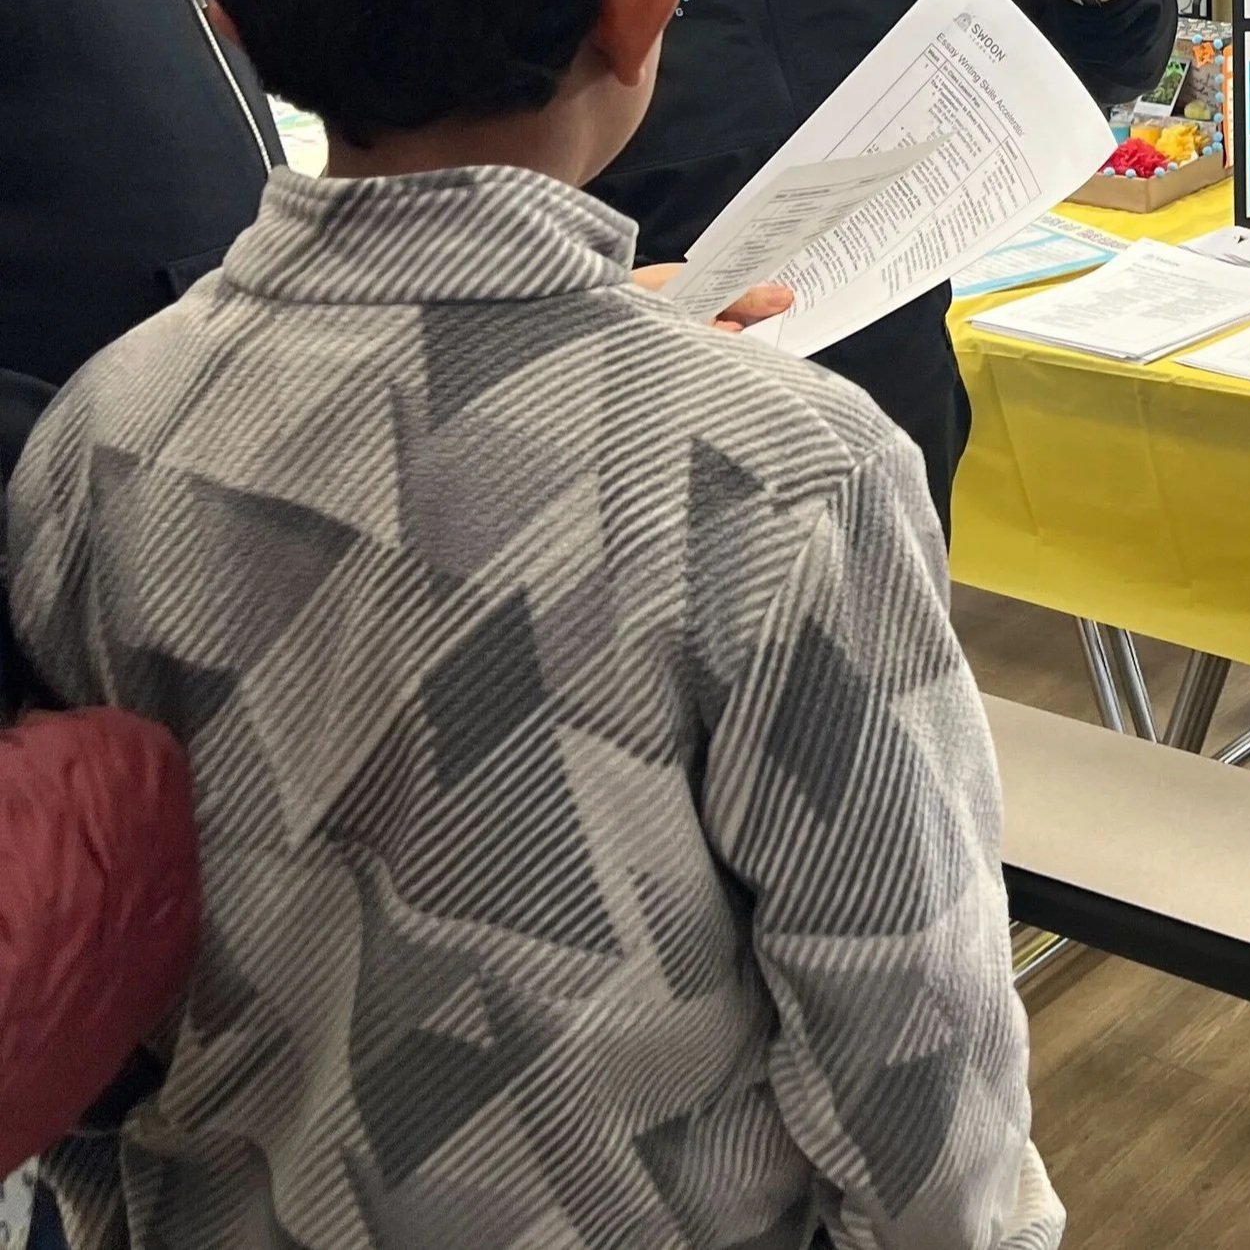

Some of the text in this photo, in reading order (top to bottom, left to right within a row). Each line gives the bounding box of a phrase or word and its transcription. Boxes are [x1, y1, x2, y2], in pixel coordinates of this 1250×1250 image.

[936, 32, 959, 58] Essay
[958, 54, 981, 83] Writing
[980, 79, 997, 101] Skills
[971, 23, 1006, 62] SWOON
